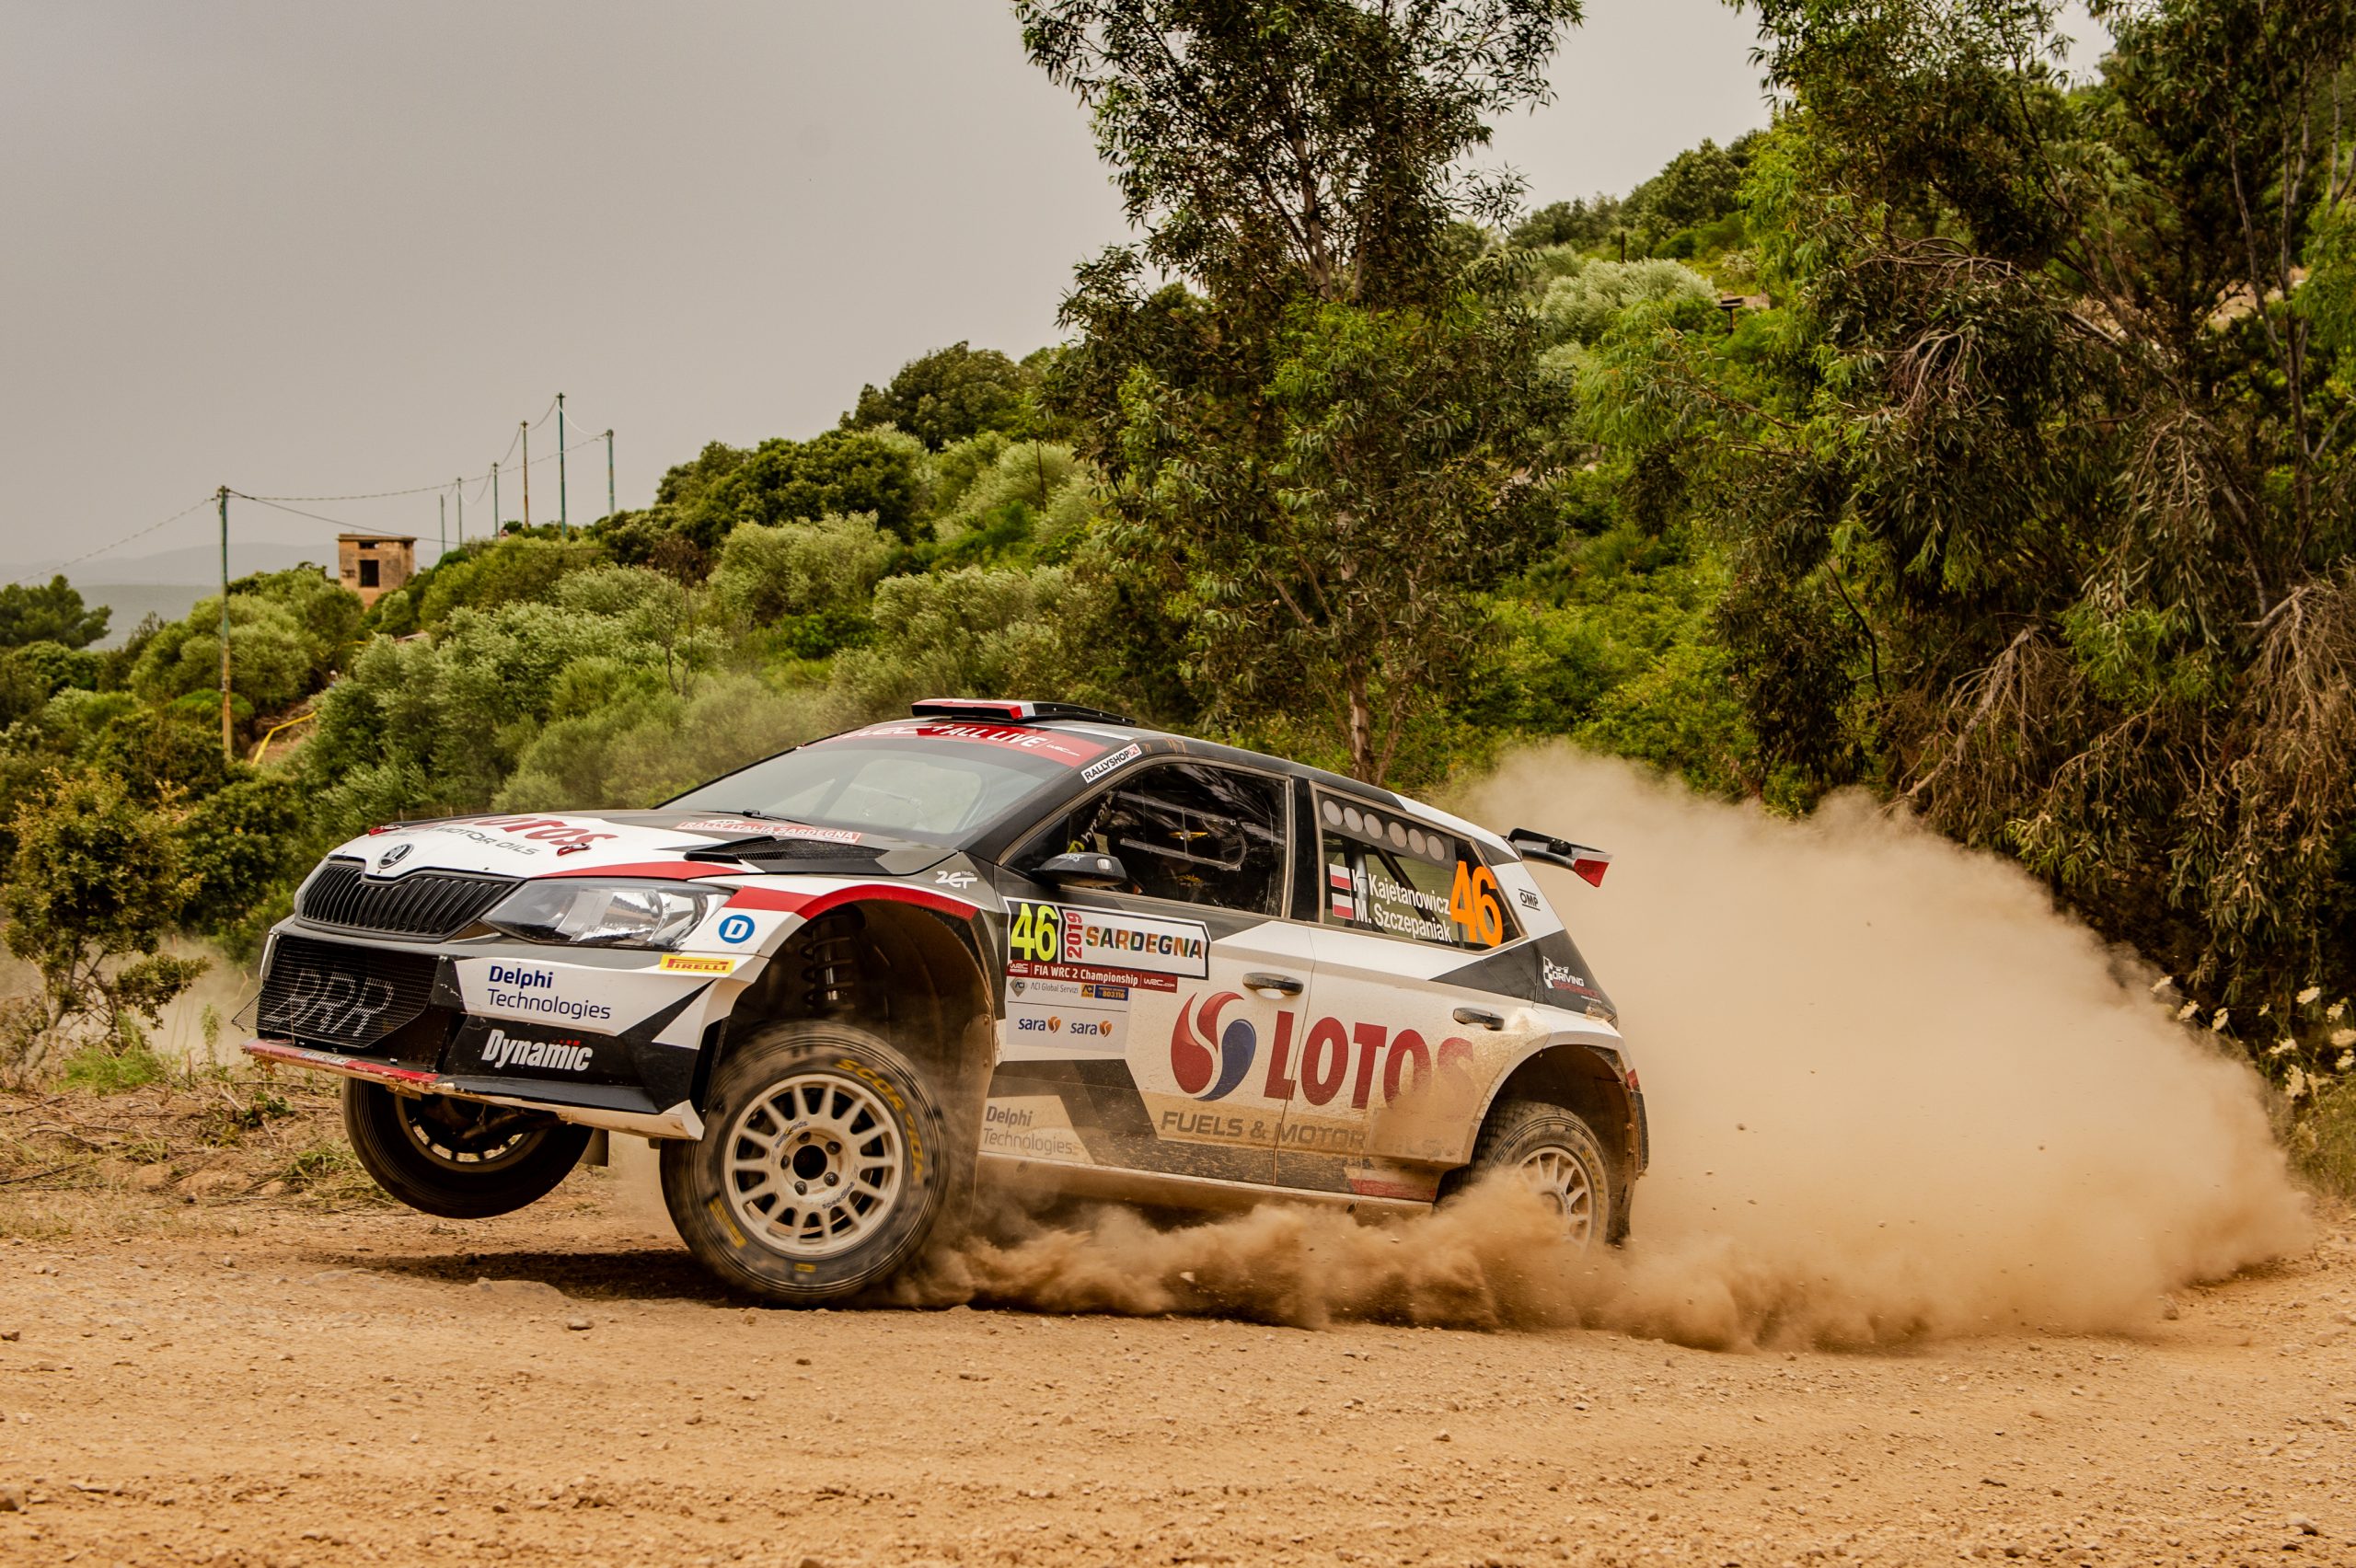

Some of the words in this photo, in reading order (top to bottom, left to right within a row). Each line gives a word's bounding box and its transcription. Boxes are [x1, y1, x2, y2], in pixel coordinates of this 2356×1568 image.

[945, 726, 990, 739] ALL
[987, 728, 1046, 747] LIVE
[1084, 749, 1130, 780] RALLYSHOP
[686, 821, 727, 831] RALLY
[730, 824, 774, 836] ITALIA
[776, 826, 854, 841] SARDEGNA
[495, 841, 541, 856] OILS
[1368, 872, 1452, 916] Kajetanowicz
[1449, 860, 1504, 948] 46
[1519, 892, 1539, 907] OMP
[1011, 903, 1058, 962] 46
[1355, 898, 1372, 924] M.
[1373, 903, 1453, 943] Szczepaniak
[1066, 912, 1083, 960] 2019
[1085, 926, 1203, 960] SARDEGNA
[489, 965, 553, 989] Delphi
[666, 958, 730, 971] PIRELLI
[1034, 964, 1049, 976] FIA
[1050, 966, 1070, 978] WRC
[1072, 968, 1079, 979] 2
[1080, 969, 1138, 987] Championship
[1042, 983, 1059, 993] Global
[1060, 985, 1079, 994] Servizi
[1552, 970, 1585, 987] DRIVING
[487, 988, 611, 1020] Technologies
[1018, 1017, 1046, 1032] sara
[1070, 1021, 1098, 1036] sara
[481, 1029, 594, 1071] Dynamic
[1264, 1010, 1473, 1121] LOTOS
[986, 1105, 1033, 1127] Delphi
[984, 1127, 1073, 1156] Technologies
[1161, 1111, 1243, 1137] FUELS
[1250, 1120, 1267, 1139] &
[1275, 1123, 1366, 1149] MOTOR
